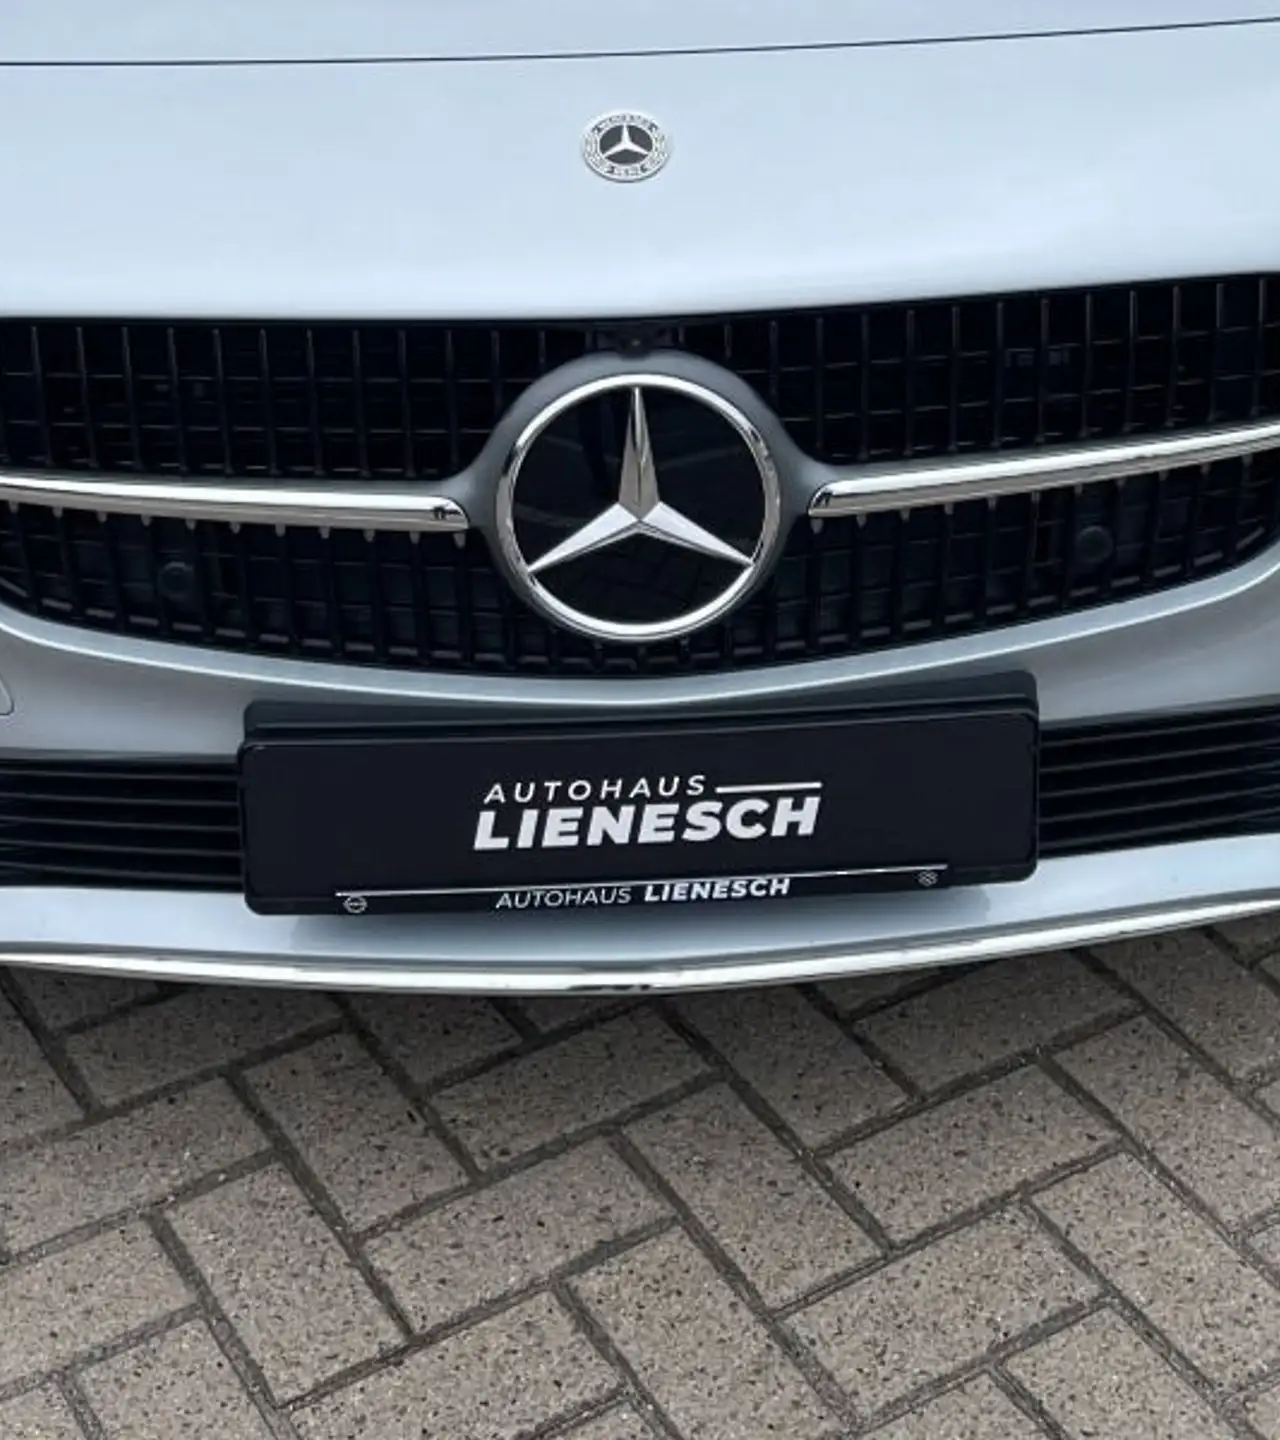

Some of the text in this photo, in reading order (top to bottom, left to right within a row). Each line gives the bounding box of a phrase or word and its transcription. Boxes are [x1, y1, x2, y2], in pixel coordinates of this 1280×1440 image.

[484, 775, 707, 804] AUTOHAUS
[473, 796, 821, 851] LIENESCH
[495, 878, 791, 909] AUTOHAUS LIENESCH
